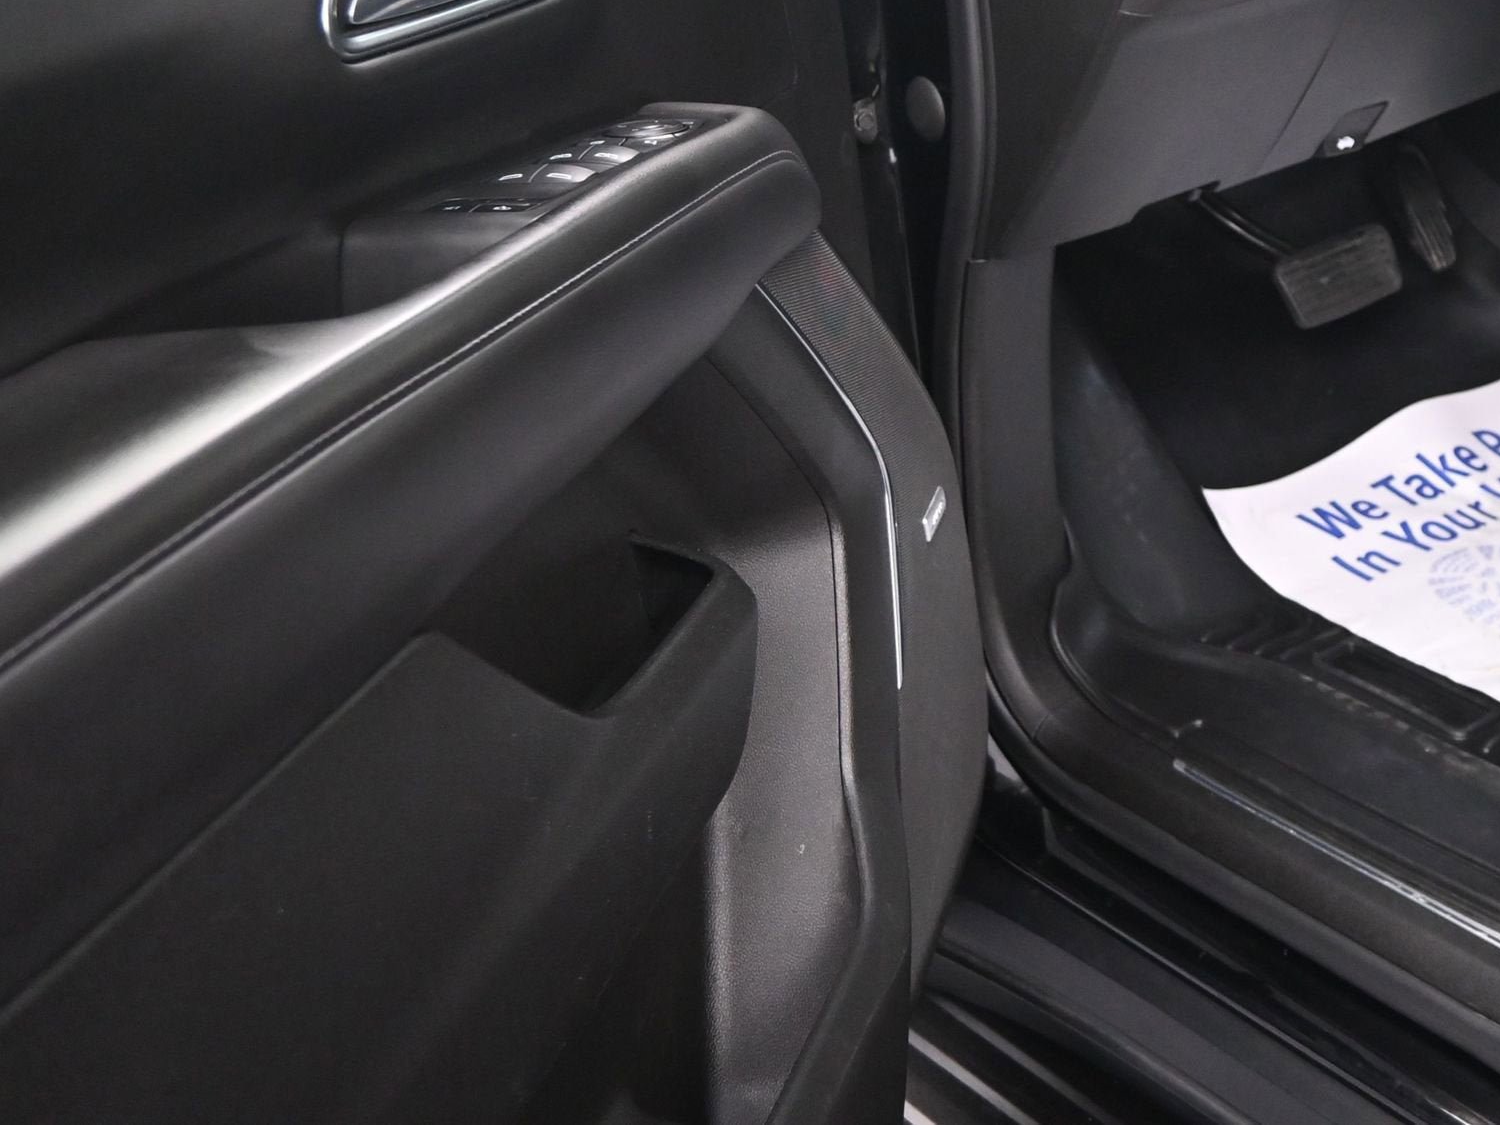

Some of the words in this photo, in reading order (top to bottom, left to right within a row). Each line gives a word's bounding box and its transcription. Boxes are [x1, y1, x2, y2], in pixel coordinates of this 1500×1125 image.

[1295, 500, 1390, 540] We
[1371, 453, 1489, 506] Take
[1330, 549, 1402, 583] In
[1381, 500, 1500, 553] Your
